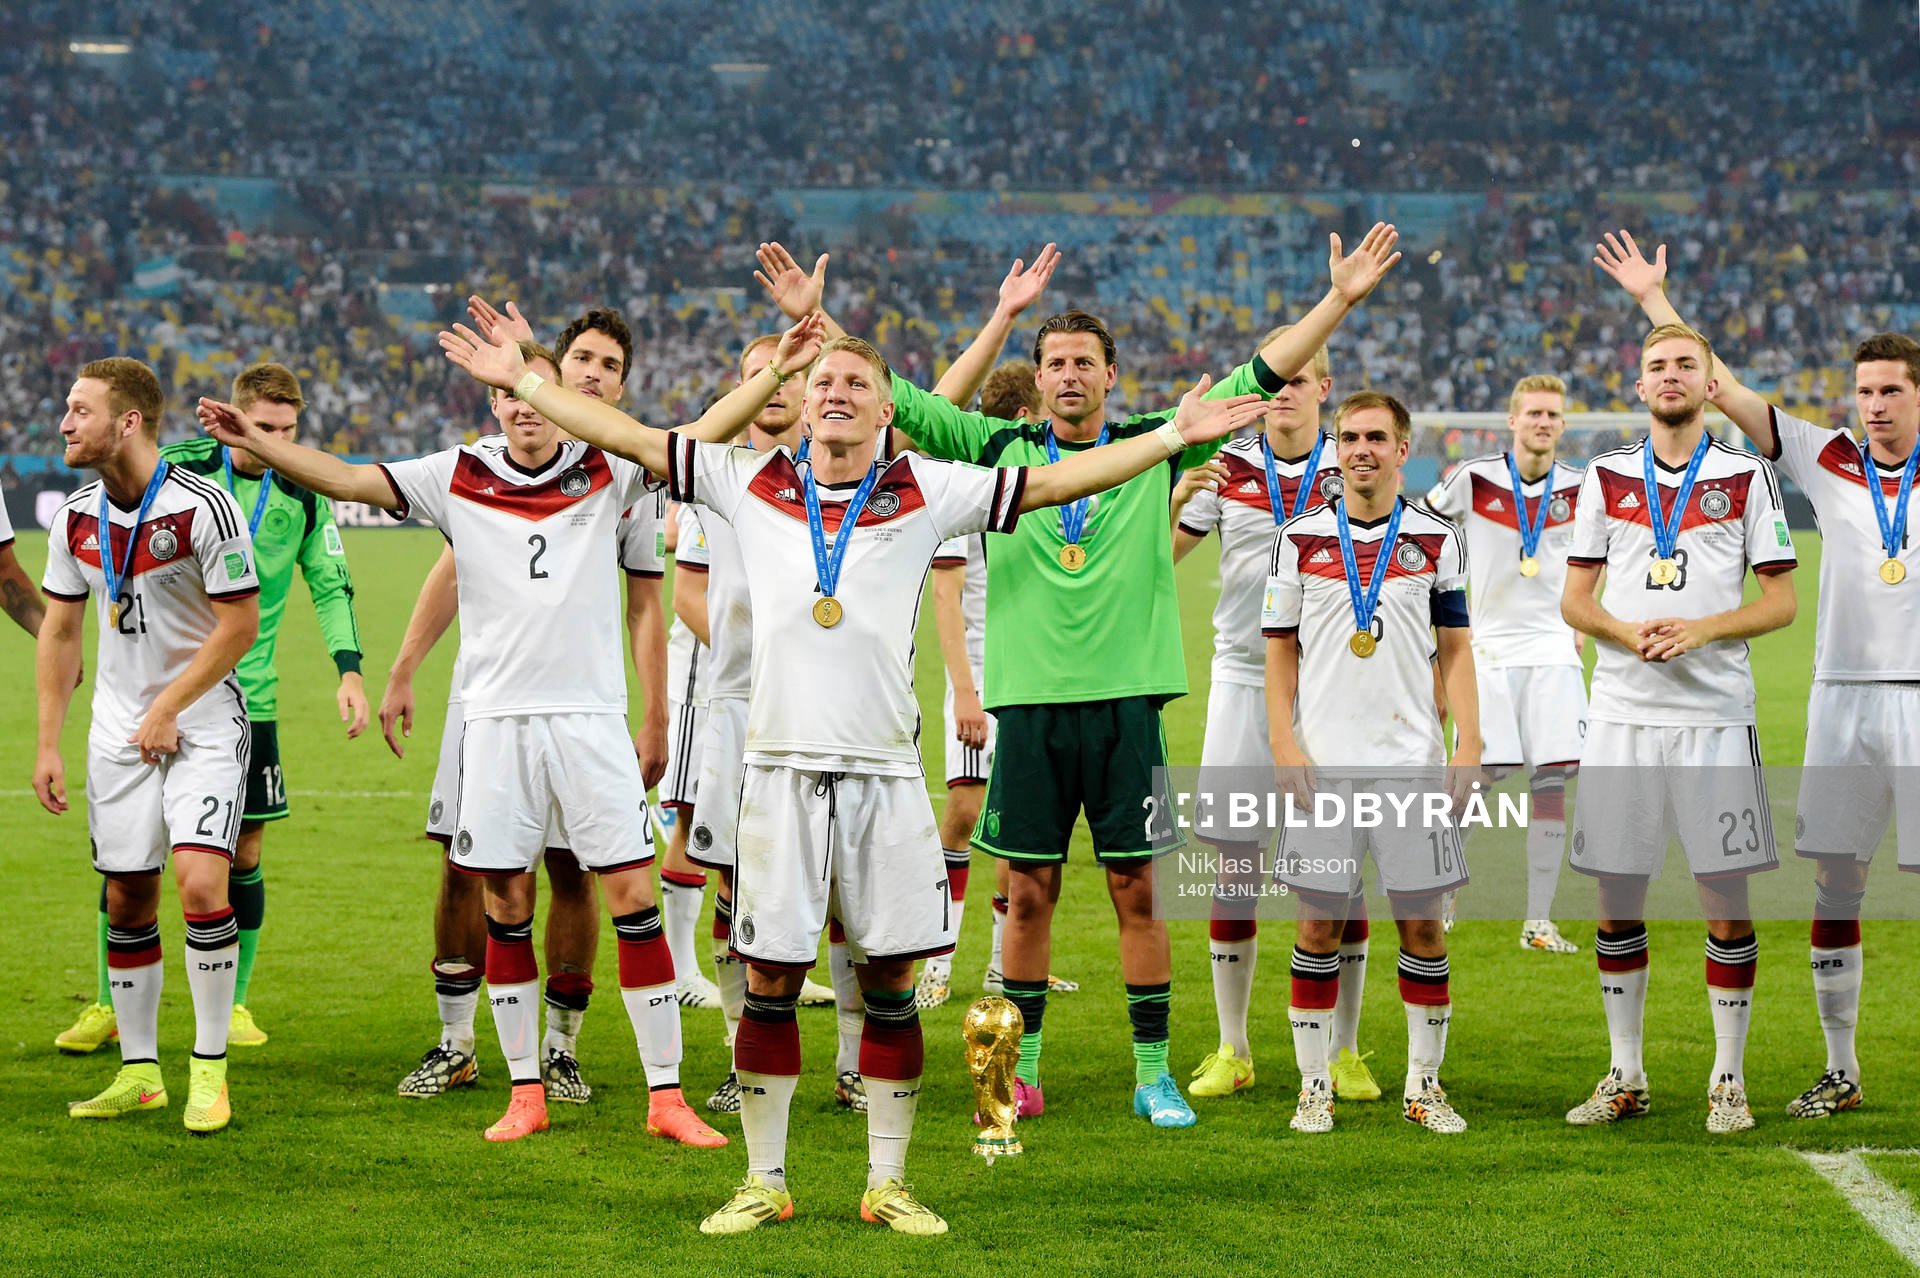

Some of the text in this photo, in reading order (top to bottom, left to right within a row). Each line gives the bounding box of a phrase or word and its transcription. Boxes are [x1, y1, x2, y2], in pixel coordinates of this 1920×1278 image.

[528, 534, 548, 579] 2
[117, 592, 147, 634] 21
[262, 765, 286, 806] 12
[196, 796, 233, 839] 21
[639, 800, 653, 844] 2
[1718, 808, 1760, 857] 23
[1427, 829, 1453, 876] 16
[936, 879, 949, 932] 7
[198, 960, 233, 971] DFB
[715, 955, 745, 965] DF
[1811, 959, 1844, 969] DFB
[110, 981, 134, 989] FB
[1602, 985, 1624, 995] FB
[1717, 999, 1748, 1008] DFB
[1427, 1017, 1450, 1026] DF
